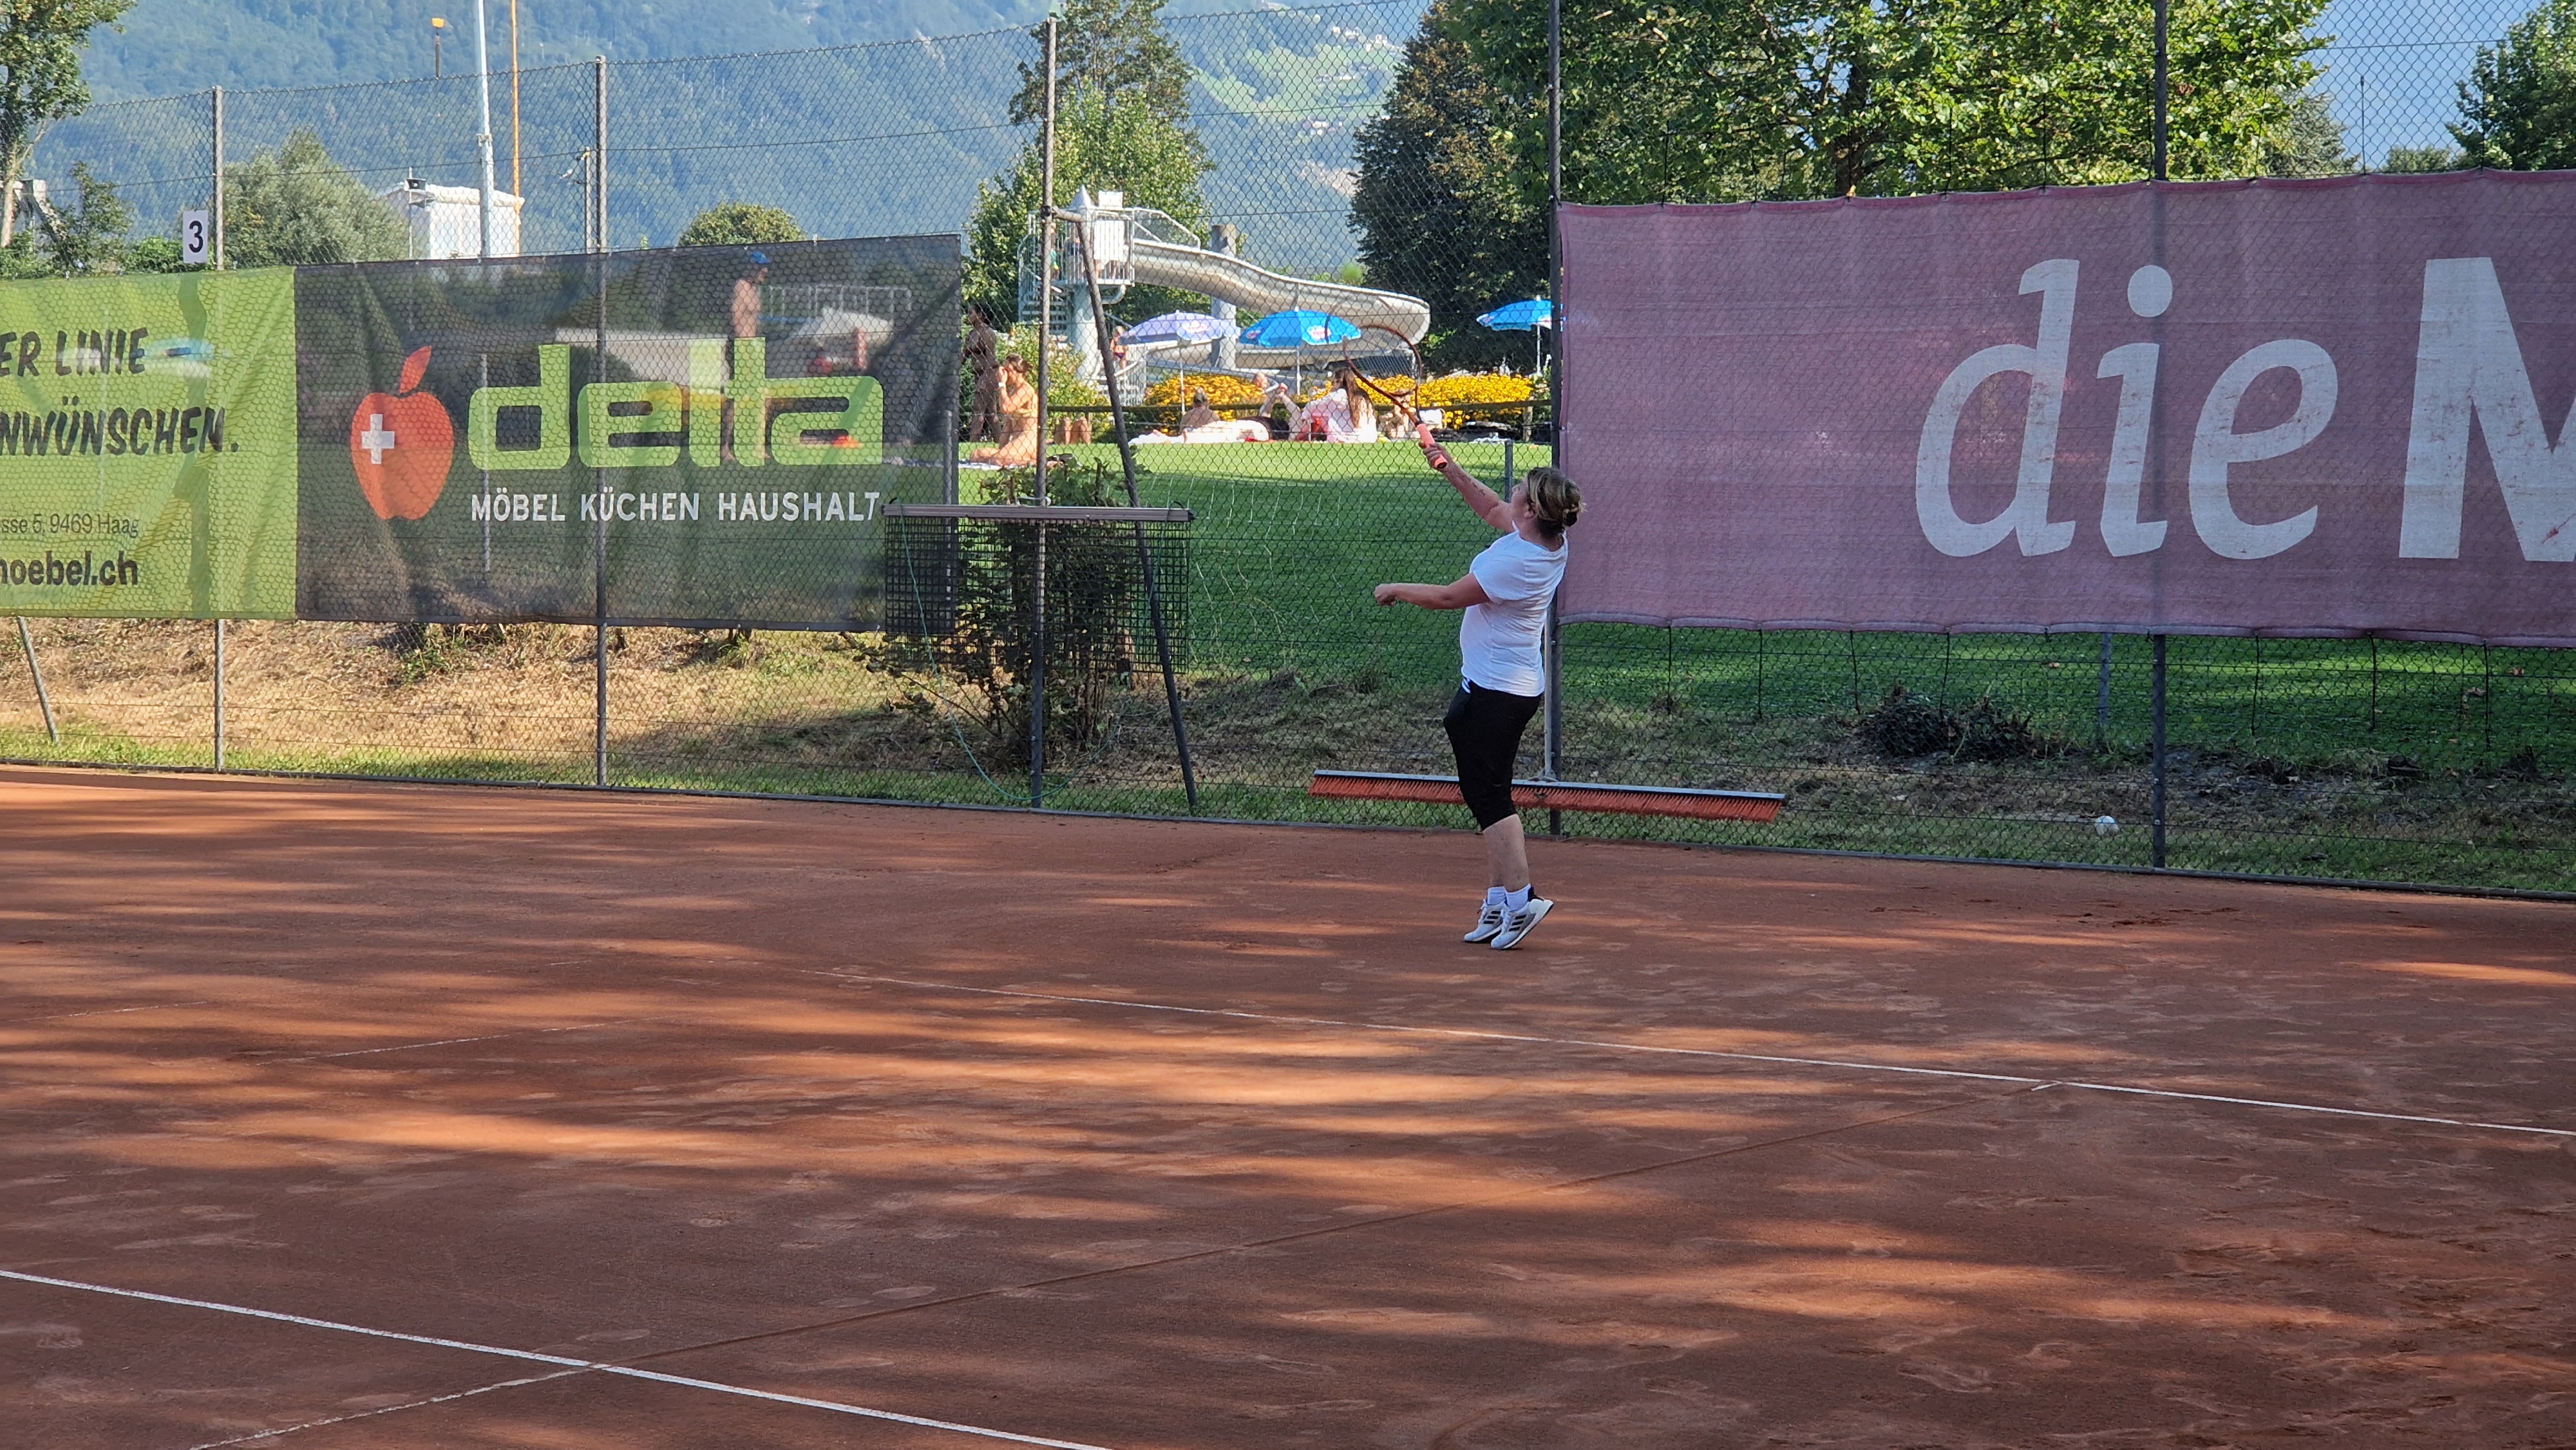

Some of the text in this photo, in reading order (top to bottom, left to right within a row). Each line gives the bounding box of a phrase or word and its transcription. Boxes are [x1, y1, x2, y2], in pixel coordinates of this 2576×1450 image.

[188, 220, 204, 252] 3
[55, 327, 149, 377] LINIE
[468, 337, 884, 470] delta
[1915, 258, 2338, 560] die
[50, 513, 93, 534] 9469
[97, 513, 140, 538] Haag
[471, 486, 880, 522] MÖBEL KÜCHEN HAUSHALT
